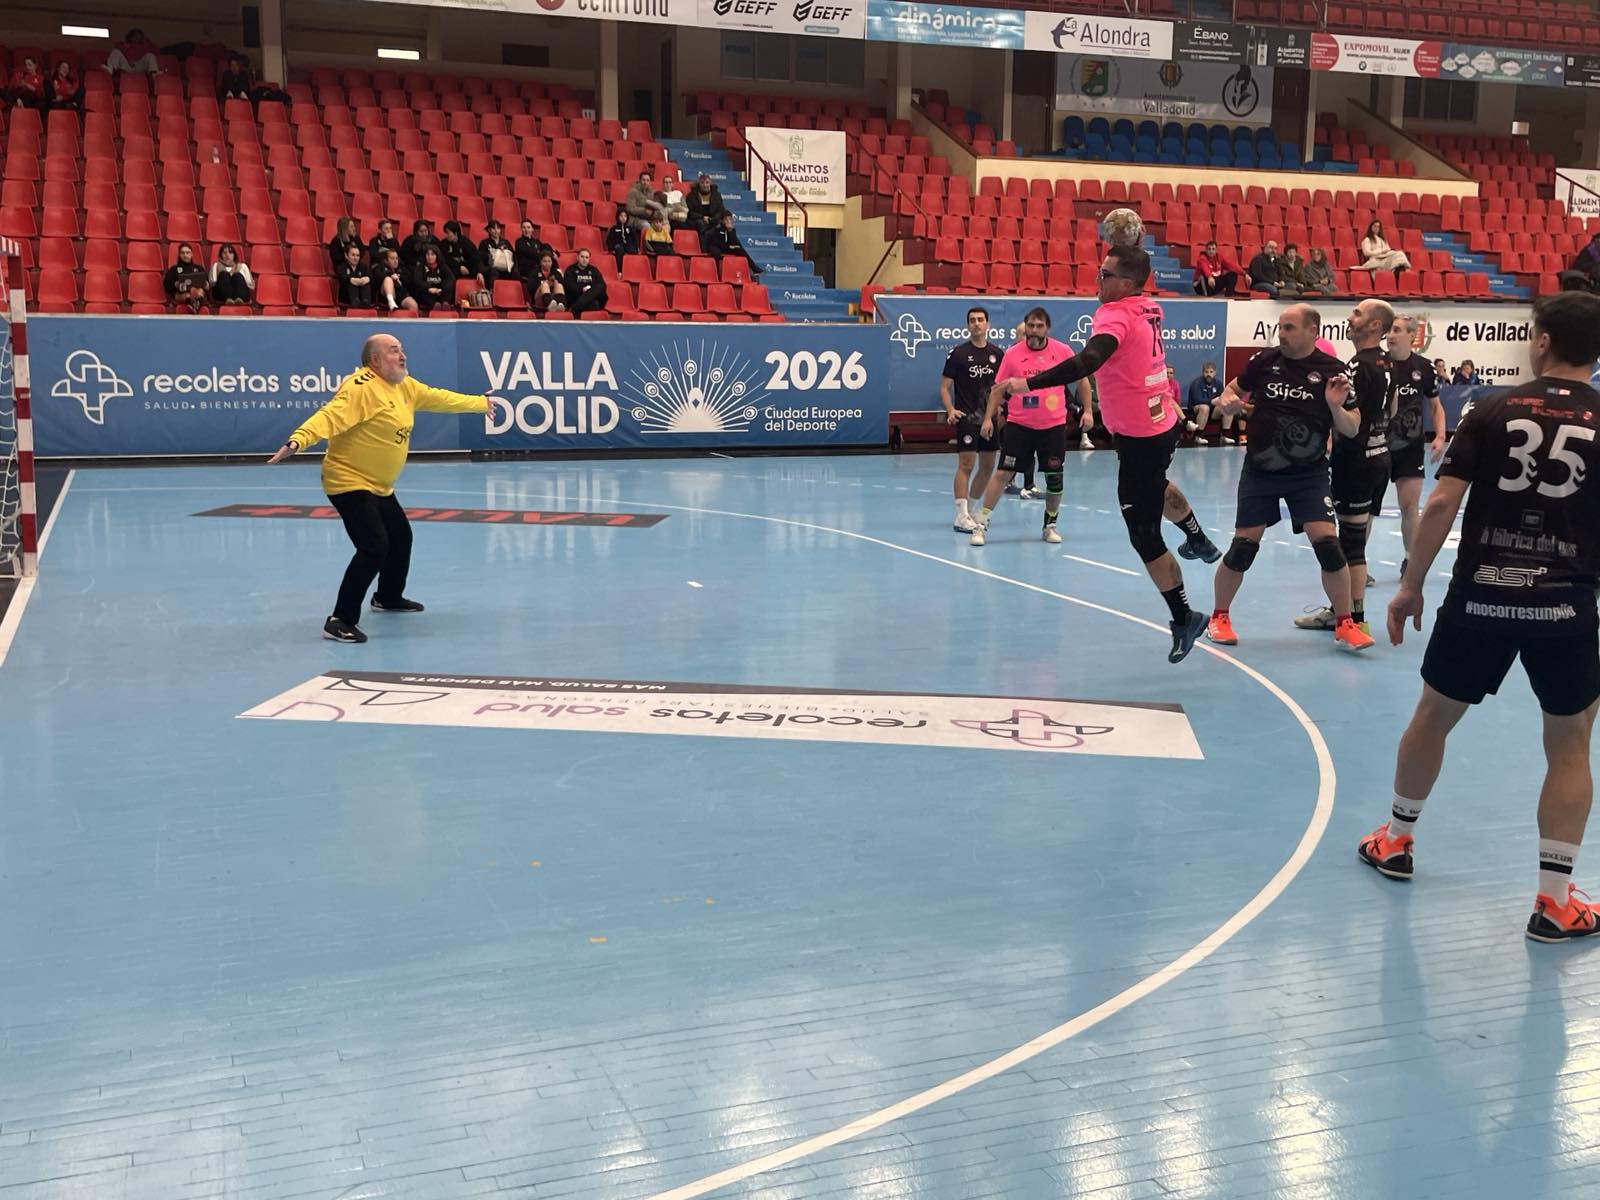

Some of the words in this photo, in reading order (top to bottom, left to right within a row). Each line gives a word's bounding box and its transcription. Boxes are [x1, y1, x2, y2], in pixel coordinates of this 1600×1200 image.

[734, 1, 777, 15] GEFF
[812, 6, 852, 21] GEFF
[1080, 22, 1150, 47] Alondra
[1344, 43, 1389, 53] EXPOMOVIL
[1143, 101, 1196, 116] Valladolid
[778, 172, 829, 183] VALLADOLID
[1571, 198, 1600, 206] LIMEN
[791, 291, 816, 300] Recoletas
[1181, 324, 1215, 340] salud
[1446, 322, 1469, 341] de
[1474, 322, 1532, 341] Vallad
[480, 351, 619, 390] VALLA
[765, 350, 867, 390] 2026
[1451, 366, 1520, 377] Mnicipal
[143, 366, 280, 393] recoletas
[485, 395, 620, 435] DOLID
[765, 407, 808, 419] Ciudad
[812, 407, 862, 421] Europea
[764, 419, 784, 431] del
[787, 420, 837, 431] Deporte
[1498, 418, 1595, 498] 35
[473, 702, 629, 717] salud
[650, 708, 927, 728] recoletas
